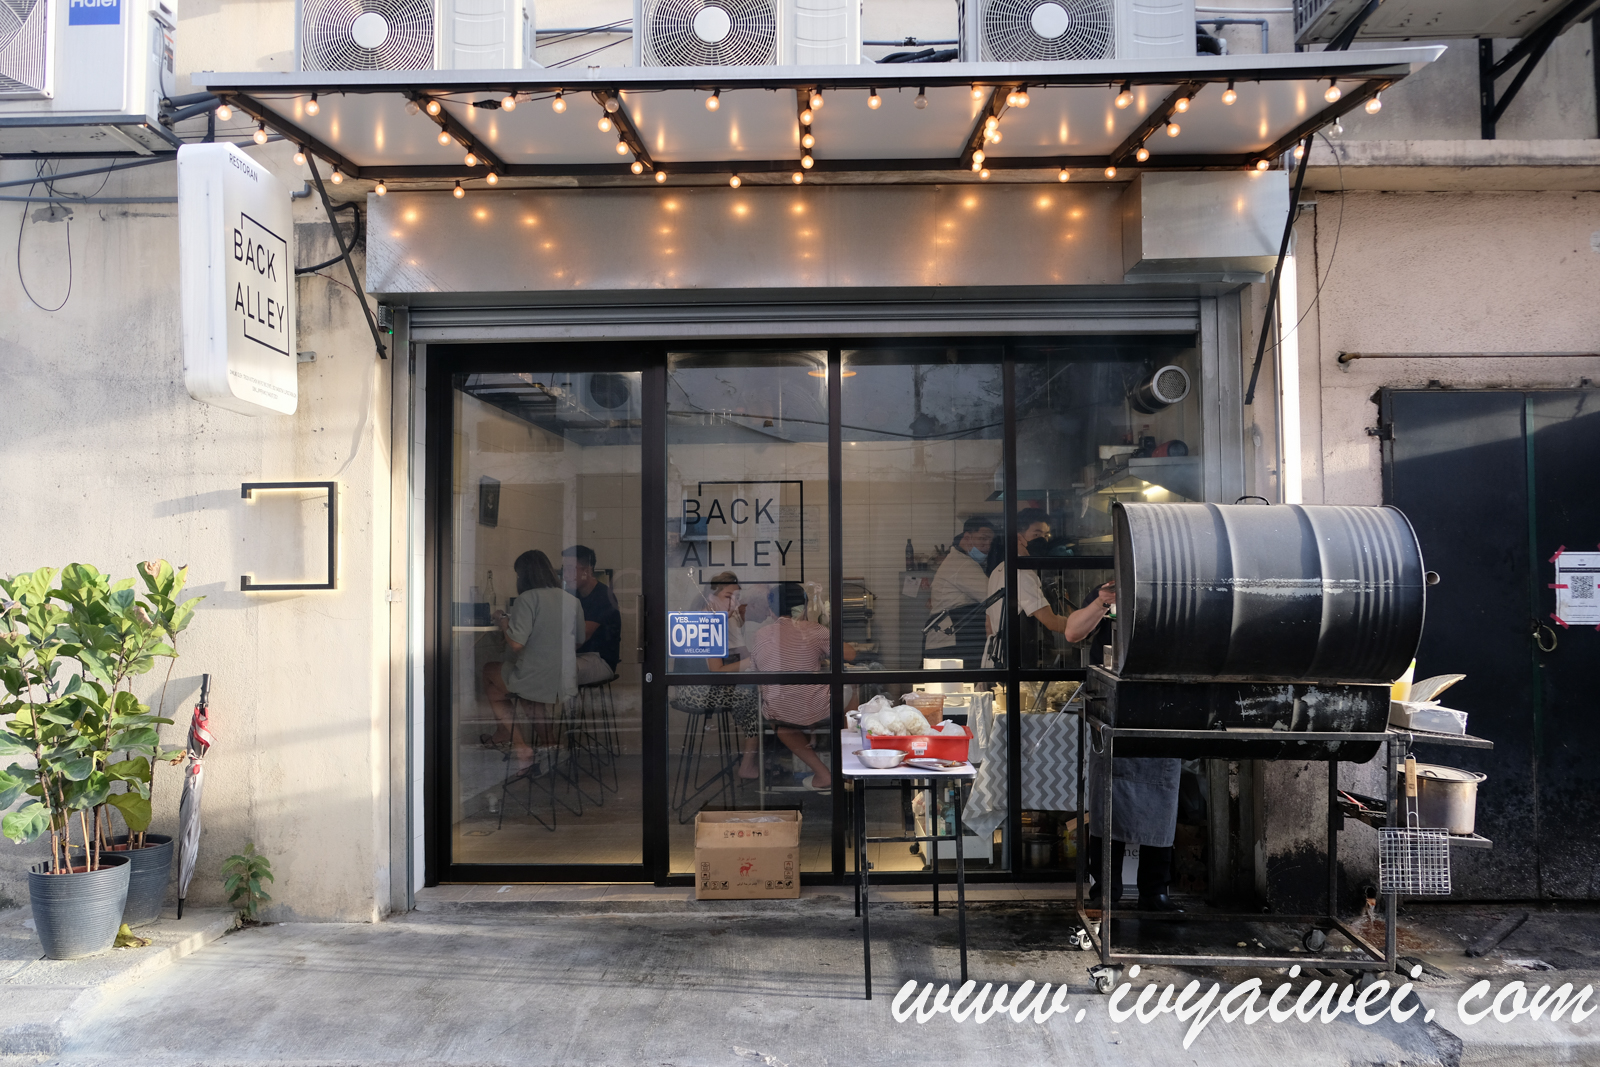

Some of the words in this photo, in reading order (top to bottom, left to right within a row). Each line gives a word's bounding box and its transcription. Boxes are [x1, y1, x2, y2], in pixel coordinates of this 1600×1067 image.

[229, 153, 258, 182] RESTORAN
[234, 228, 276, 282] BACK
[234, 282, 284, 333] ALLEY
[683, 499, 774, 524] BACK
[681, 541, 792, 566] ALLEY
[672, 623, 723, 648] OPEN
